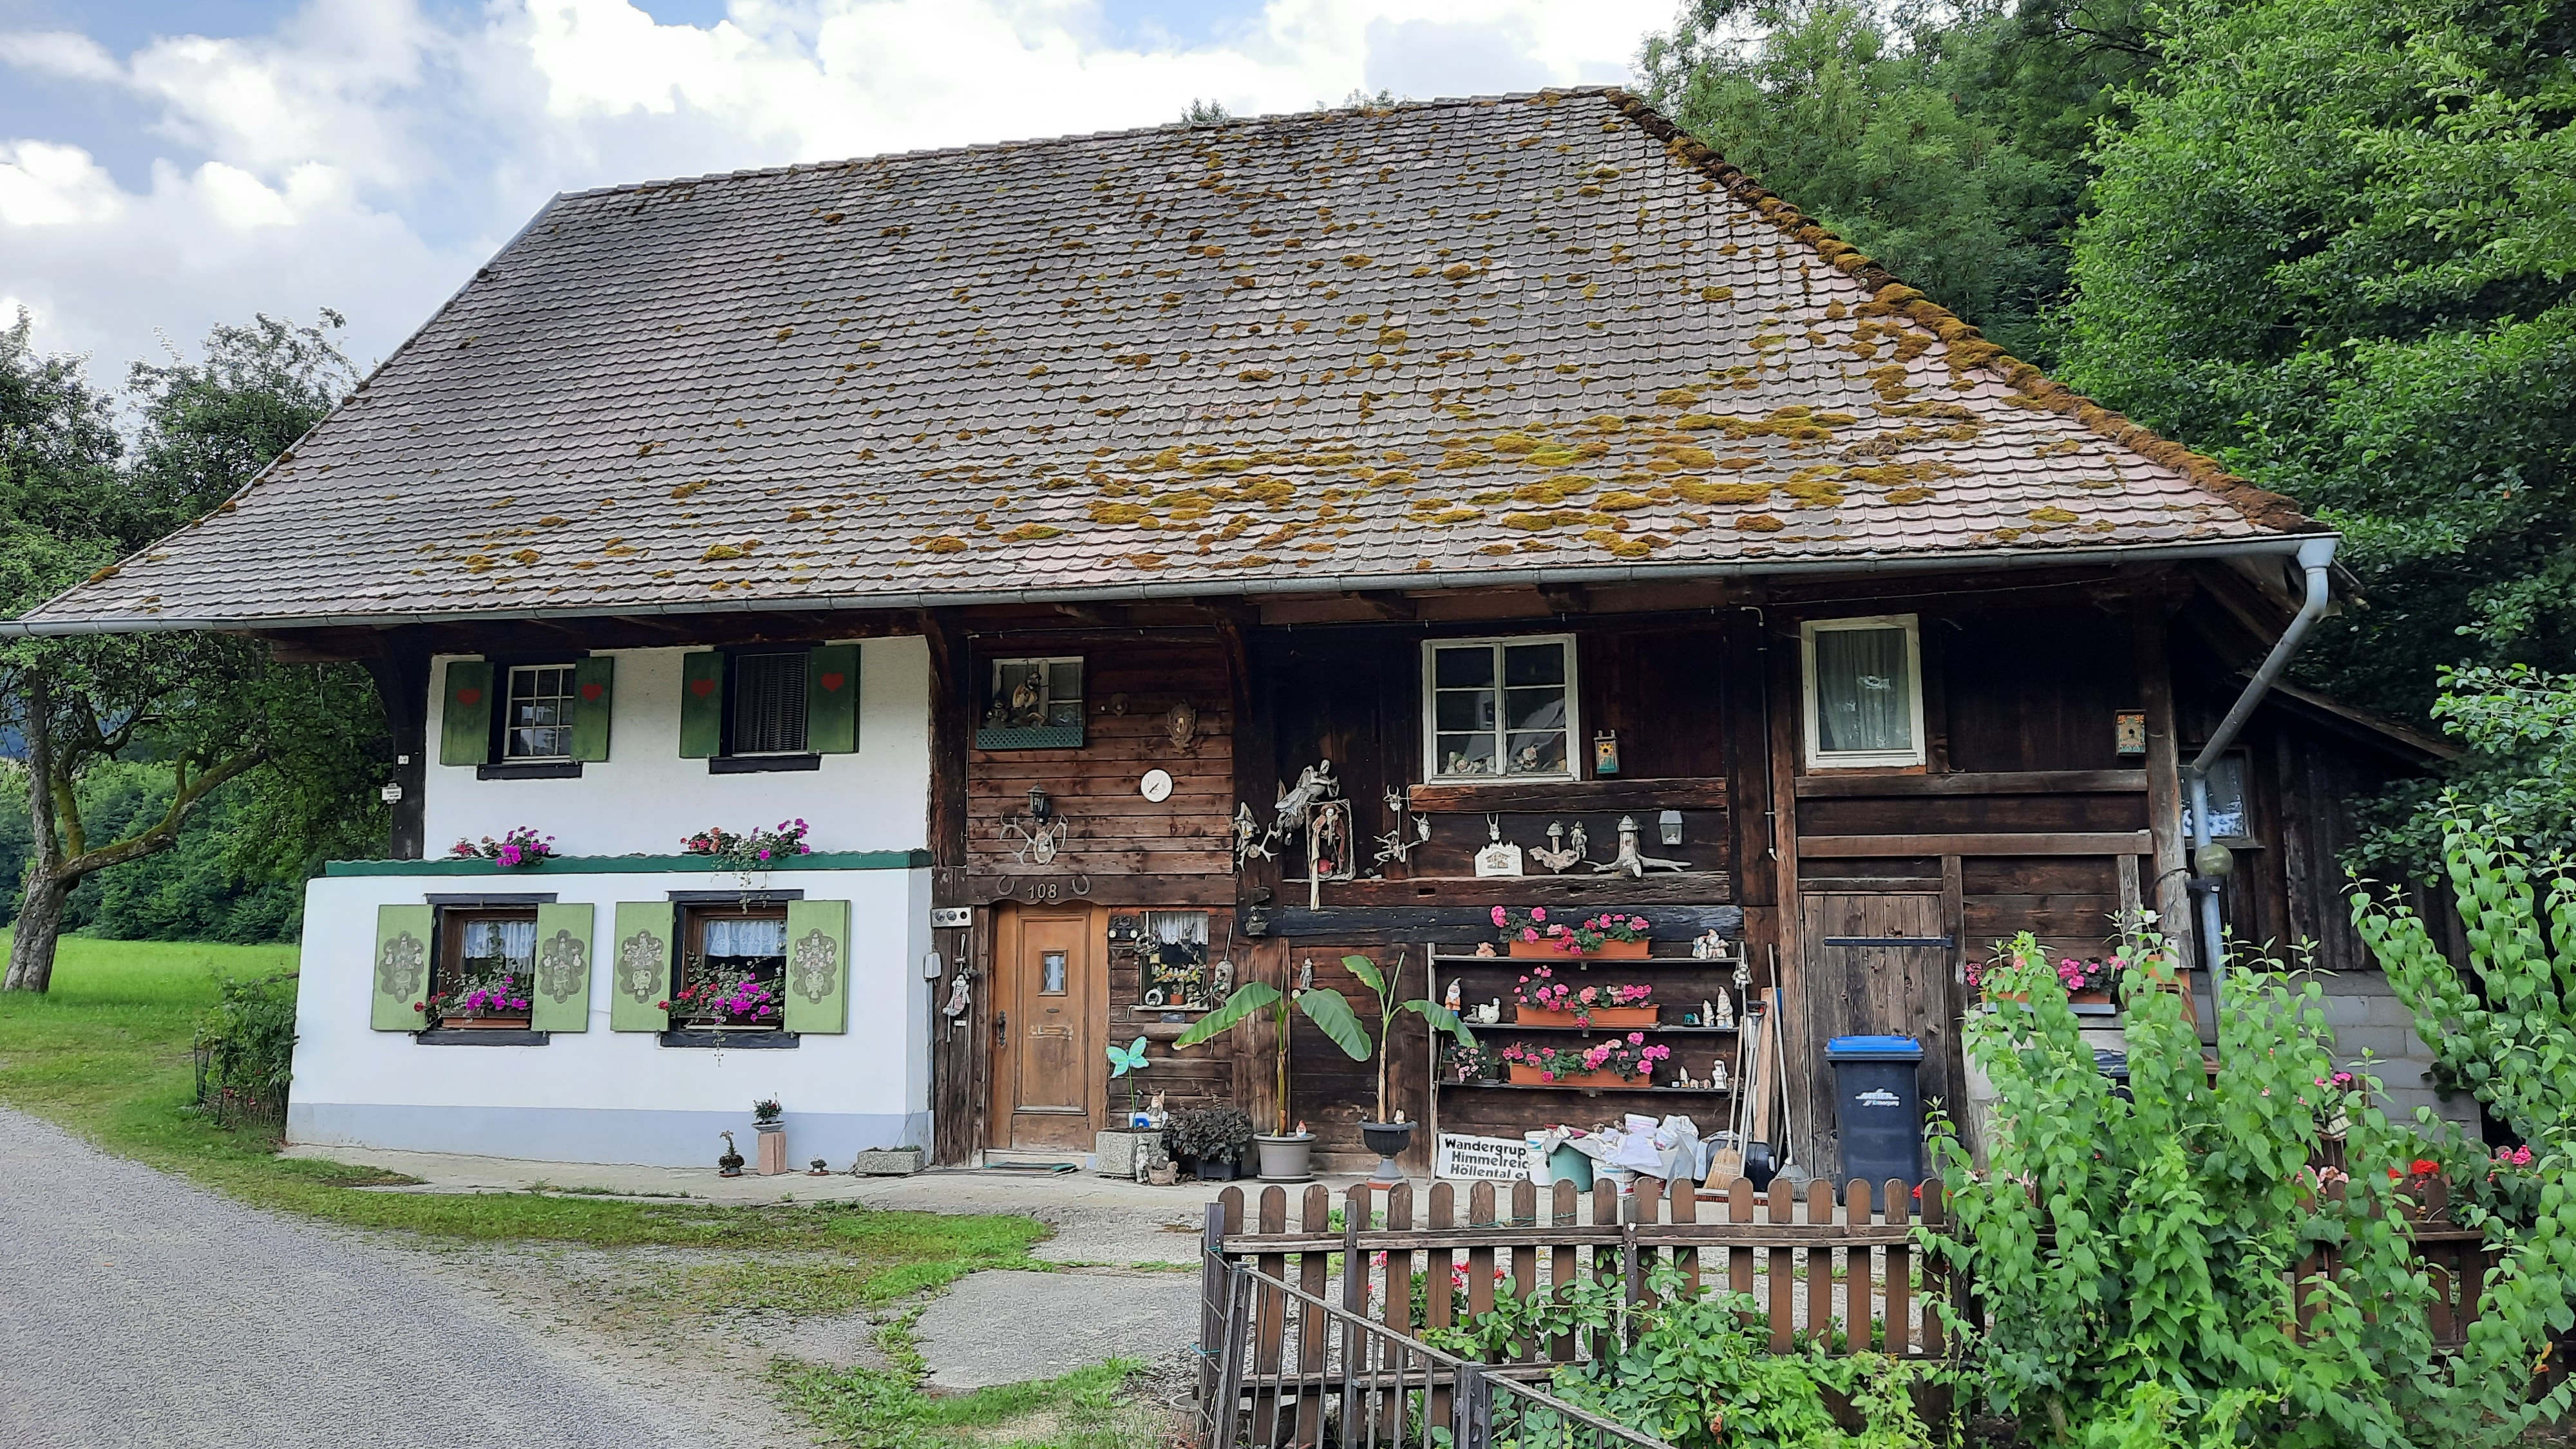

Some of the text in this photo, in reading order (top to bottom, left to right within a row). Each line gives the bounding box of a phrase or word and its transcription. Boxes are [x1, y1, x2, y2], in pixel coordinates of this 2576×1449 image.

[1027, 883, 1057, 900] 108
[1444, 1137, 1526, 1160] Wandergrup
[1452, 1151, 1529, 1169] Himmelreic
[1450, 1163, 1511, 1179] Höllental
